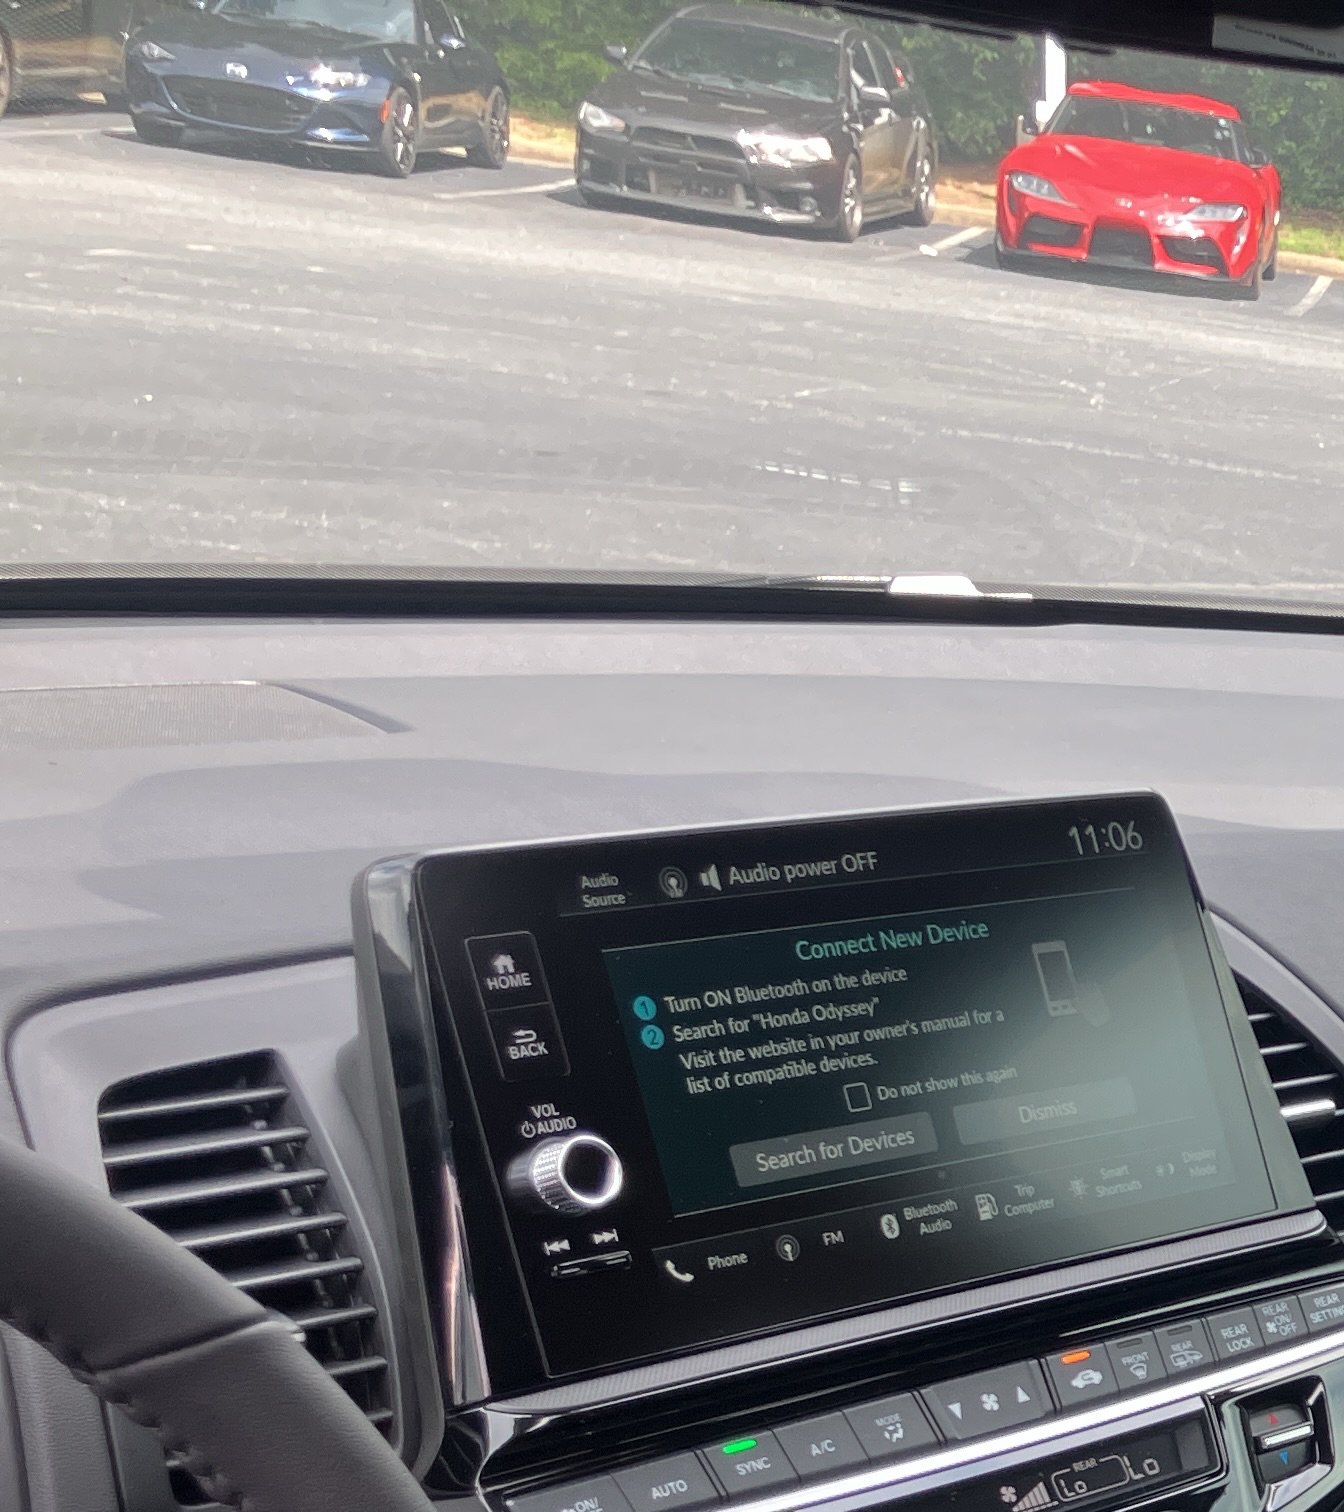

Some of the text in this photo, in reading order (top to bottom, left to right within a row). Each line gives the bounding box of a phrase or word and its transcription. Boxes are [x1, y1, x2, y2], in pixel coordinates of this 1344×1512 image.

[1068, 820, 1143, 855] 11:06
[729, 851, 878, 884] Audio power OFF
[581, 872, 619, 889] Audio
[582, 892, 626, 908] Source
[795, 920, 990, 960] Connect New Device
[486, 972, 533, 991] HOME
[664, 996, 701, 1014] Turn
[703, 991, 732, 1008] ON
[735, 979, 810, 1003] Bluetooth
[812, 978, 832, 993] on
[834, 973, 859, 990] the
[862, 966, 909, 987] device
[672, 1021, 725, 1042] Search
[728, 1017, 750, 1034] for
[753, 1009, 811, 1031] "Honda
[812, 997, 880, 1022] Odyssey"
[680, 1008, 1005, 1071] Visit the website in your owner's manual for a
[508, 1041, 549, 1060] BACK
[686, 1051, 879, 1096] list of compatible devices.
[876, 1065, 1018, 1101] Do not show this again
[530, 1102, 560, 1120] VOL
[1018, 1100, 1078, 1124] Dismiss
[536, 1117, 578, 1135] AUDIO
[756, 1129, 916, 1173] Search for Devices
[1100, 1165, 1129, 1180] Smart
[1013, 1183, 1035, 1198] Trip
[903, 1199, 959, 1221] Bluetooth
[1004, 1198, 1055, 1217] Computer
[919, 1217, 953, 1236] Audio
[822, 1231, 845, 1247] FM
[707, 1252, 749, 1271] Phone
[1314, 1292, 1341, 1307] REAR
[1260, 1302, 1290, 1317] REAR
[1220, 1323, 1249, 1340] REAR
[1279, 1322, 1298, 1337] OFF
[1170, 1340, 1194, 1353] REAR
[1225, 1337, 1255, 1353] LOCK
[1121, 1351, 1150, 1366] FRONT
[874, 1413, 903, 1427] MODE
[809, 1440, 836, 1457] A/C
[735, 1457, 772, 1476] SYNC
[1072, 1458, 1098, 1473] REAR
[651, 1479, 688, 1500] AUTO
